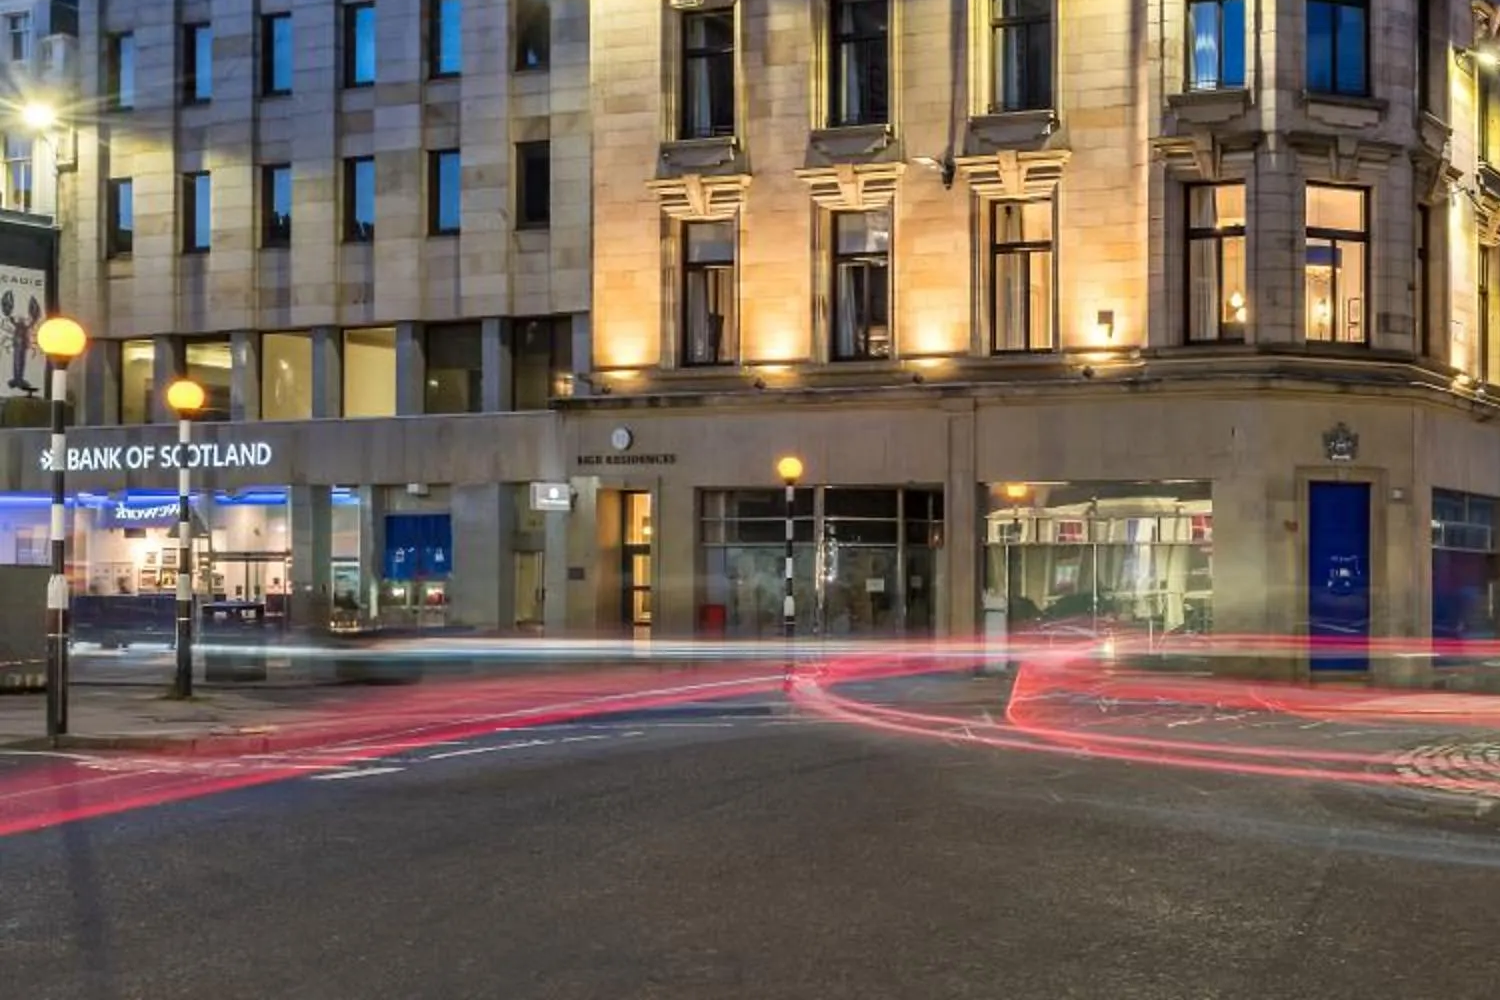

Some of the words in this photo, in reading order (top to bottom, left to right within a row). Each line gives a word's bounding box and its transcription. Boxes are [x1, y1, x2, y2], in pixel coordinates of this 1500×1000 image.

[67, 447, 121, 470] BANK
[126, 446, 155, 469] OF
[160, 443, 272, 468] SCOTLAND
